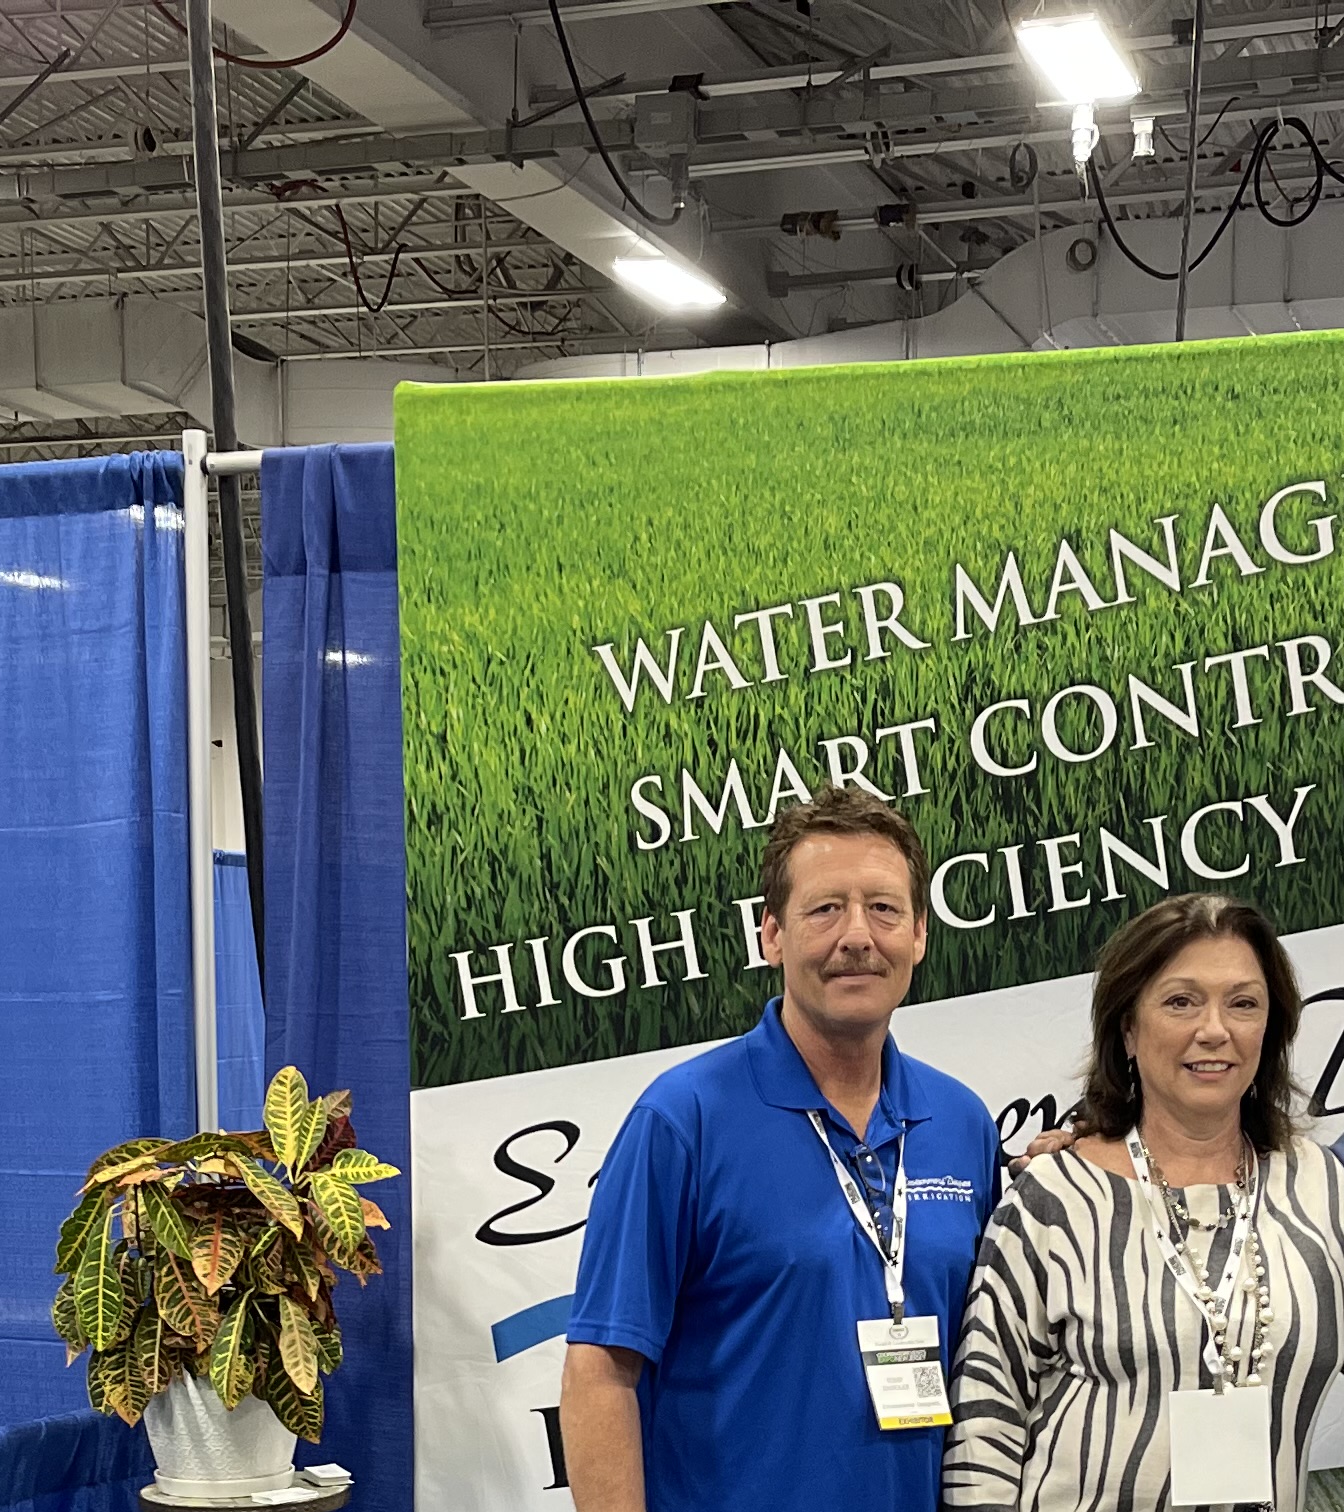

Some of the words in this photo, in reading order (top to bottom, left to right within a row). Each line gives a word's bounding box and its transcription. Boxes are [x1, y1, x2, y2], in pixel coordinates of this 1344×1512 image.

[592, 581, 932, 713] WATER
[630, 718, 936, 851] SMART
[449, 908, 709, 1021] HIGH
[732, 784, 1317, 970] ECIENCY
